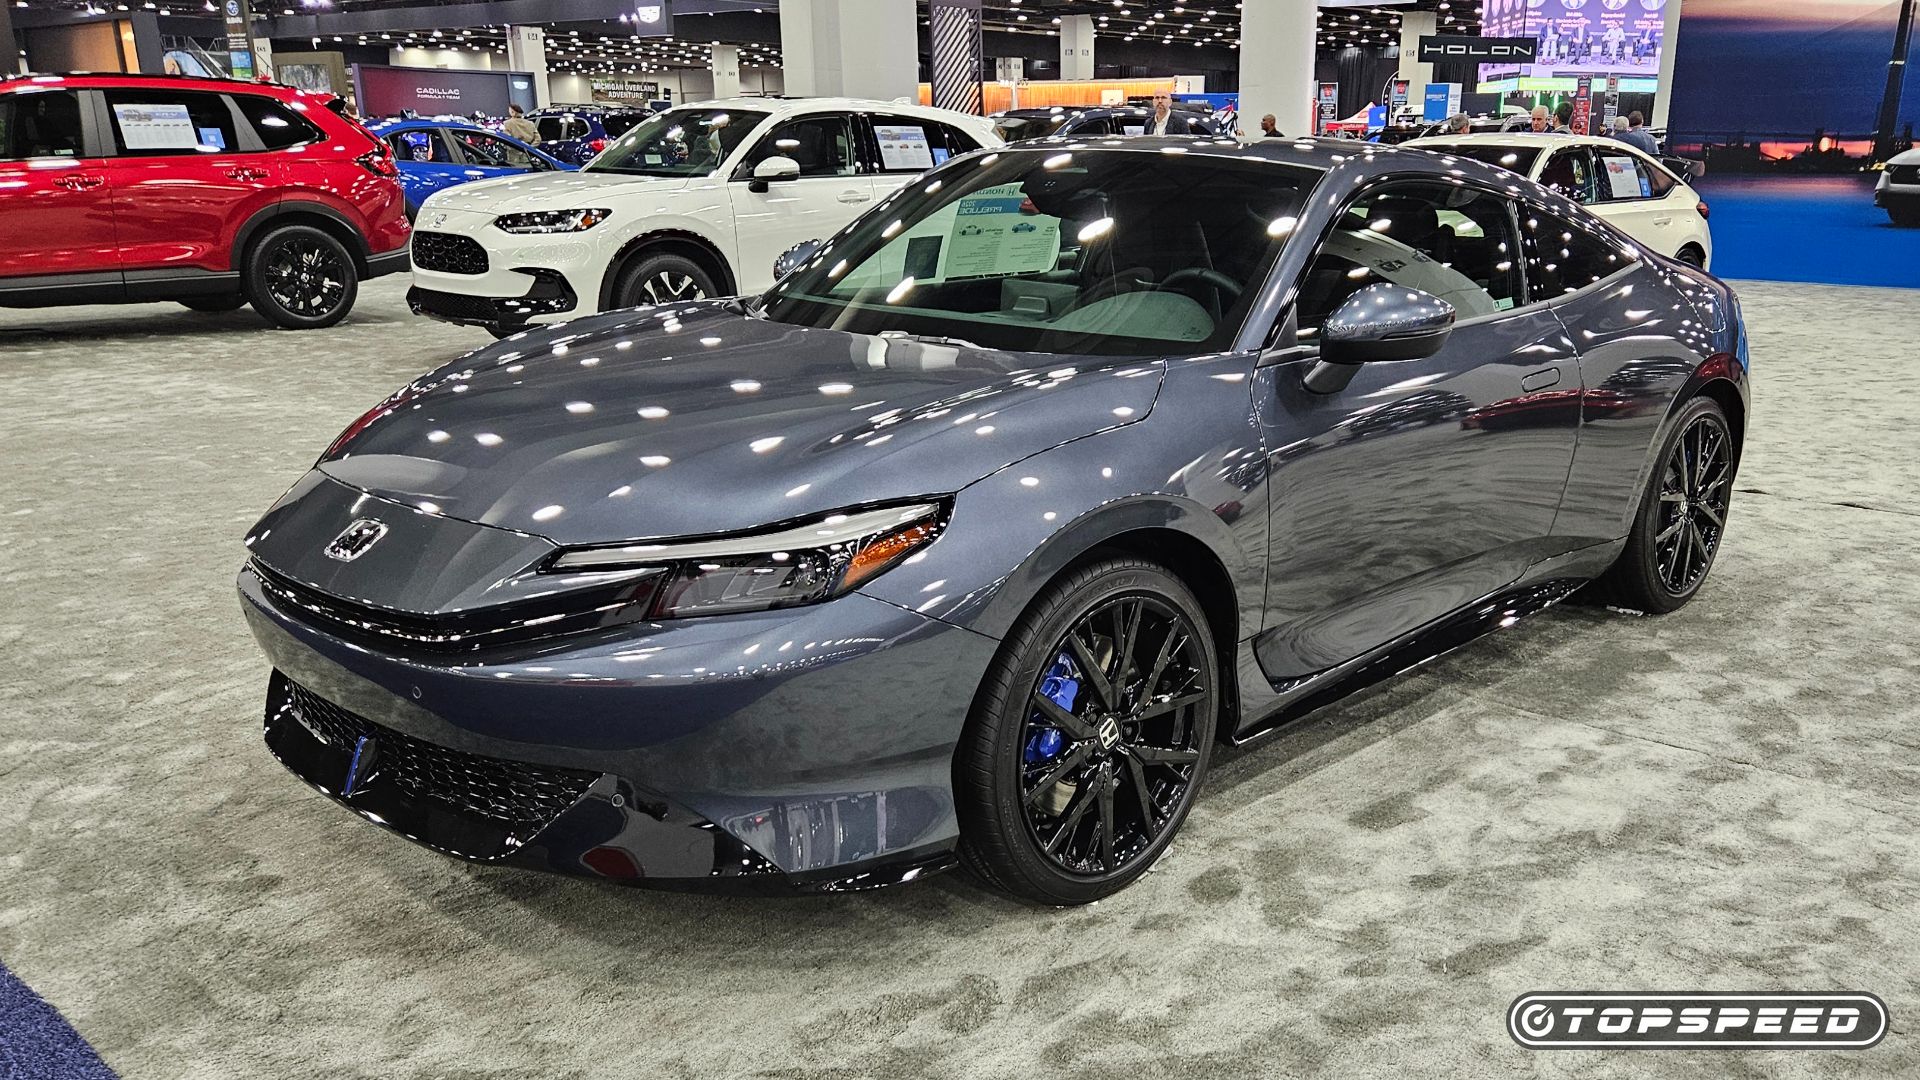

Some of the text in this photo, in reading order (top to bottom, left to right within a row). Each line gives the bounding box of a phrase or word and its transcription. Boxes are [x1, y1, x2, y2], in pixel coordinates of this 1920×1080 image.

[1424, 44, 1532, 56] HOLON
[416, 87, 460, 95] CADILLAC
[593, 83, 656, 92] MICHIGAN OVERLAND
[608, 91, 643, 99] ADVENTURE
